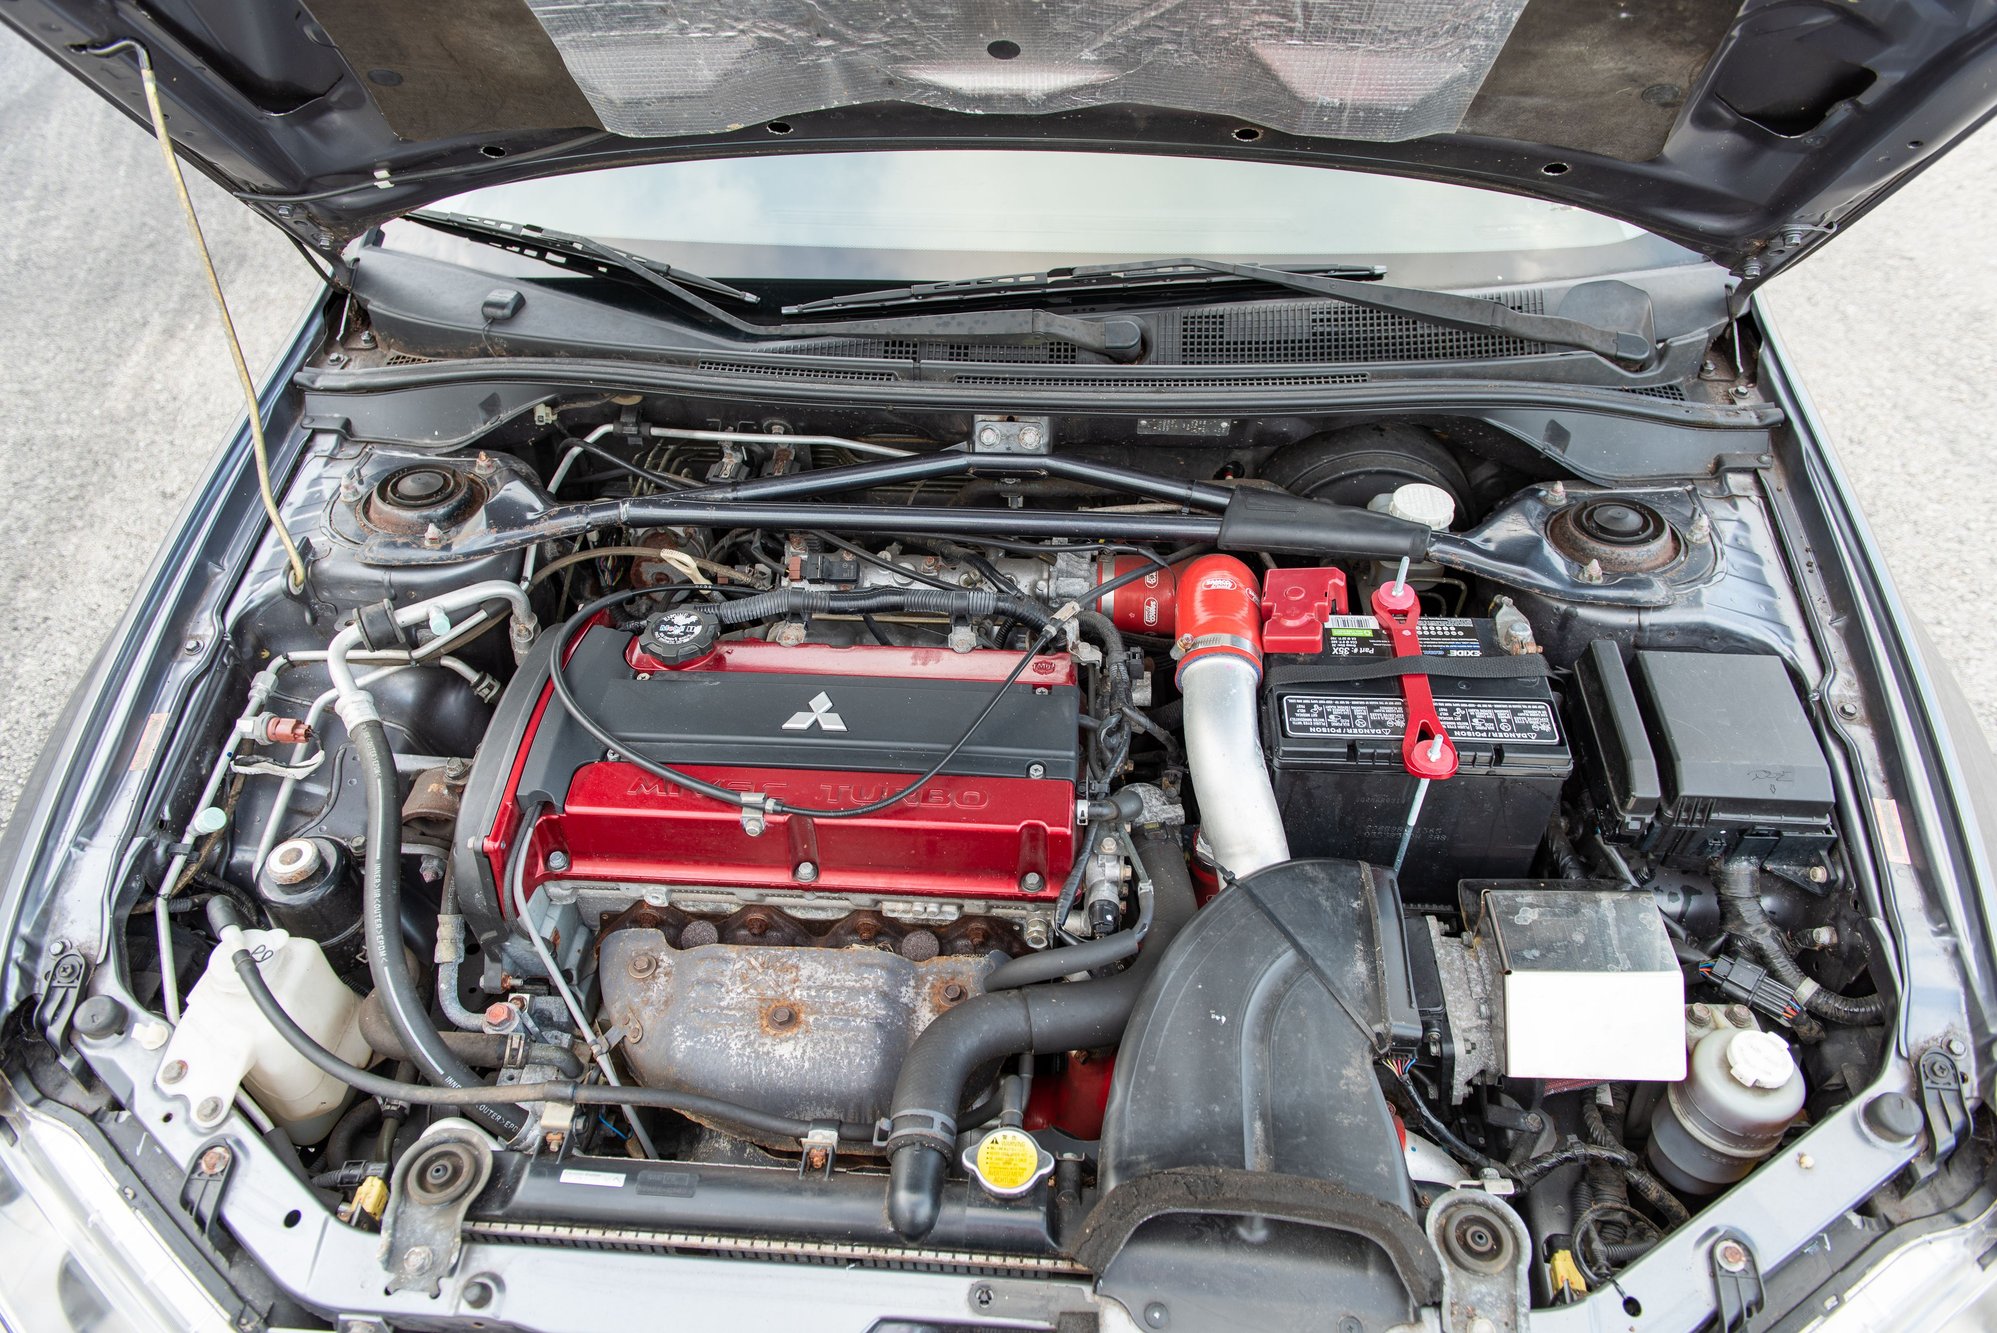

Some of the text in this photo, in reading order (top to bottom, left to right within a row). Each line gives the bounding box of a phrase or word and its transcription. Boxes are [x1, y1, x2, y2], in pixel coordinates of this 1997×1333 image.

[1331, 646, 1350, 655] 35X
[1359, 647, 1375, 655] Part
[1447, 649, 1482, 657] EXIDE
[820, 783, 989, 809] TURBO
